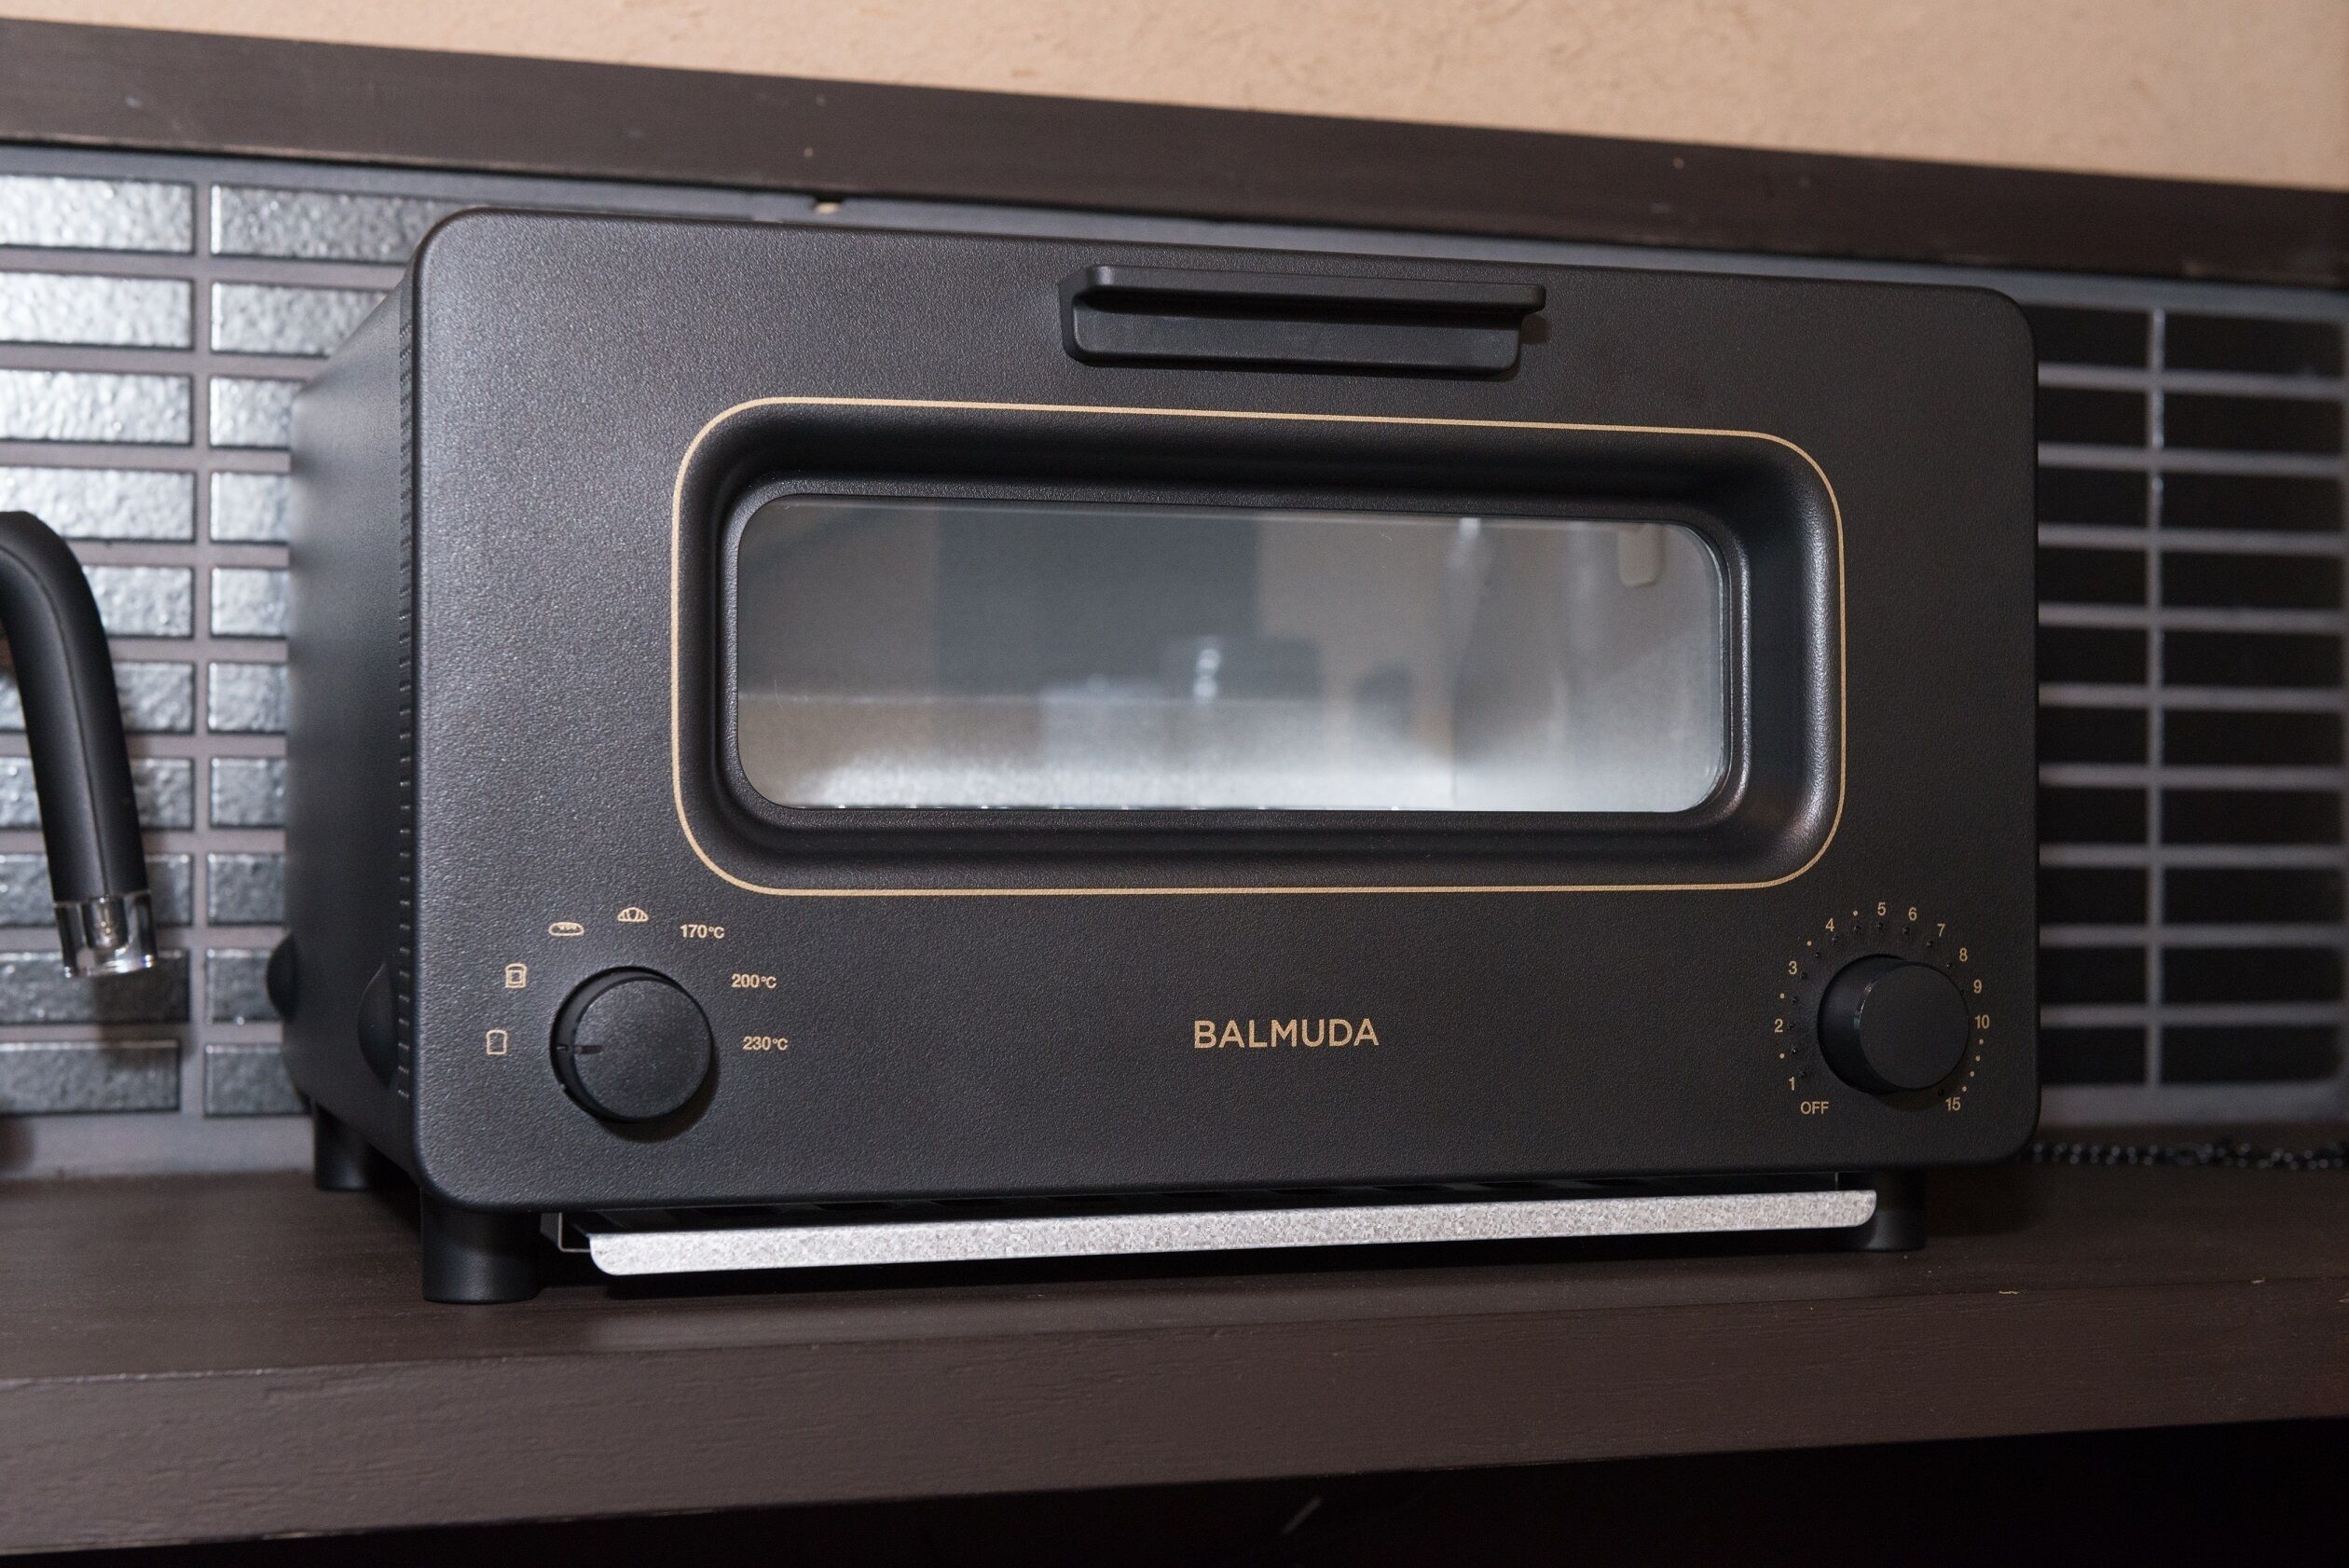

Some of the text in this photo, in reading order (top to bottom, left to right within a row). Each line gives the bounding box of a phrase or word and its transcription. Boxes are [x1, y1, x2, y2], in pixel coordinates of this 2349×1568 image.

[1877, 901, 1887, 916] 5
[1908, 907, 1917, 921] 6
[1825, 918, 1835, 932] 4
[1936, 923, 1946, 937] 7
[1958, 947, 1969, 962] 8
[1788, 960, 1798, 975] 3
[1972, 980, 1983, 994] 9
[1774, 1018, 1783, 1033] 2
[1974, 1014, 1990, 1028] 10
[1194, 1018, 1380, 1049] BALMUDA
[1788, 1077, 1795, 1091] 1
[1800, 1101, 1829, 1115] OFF
[1945, 1096, 1961, 1111] 15
